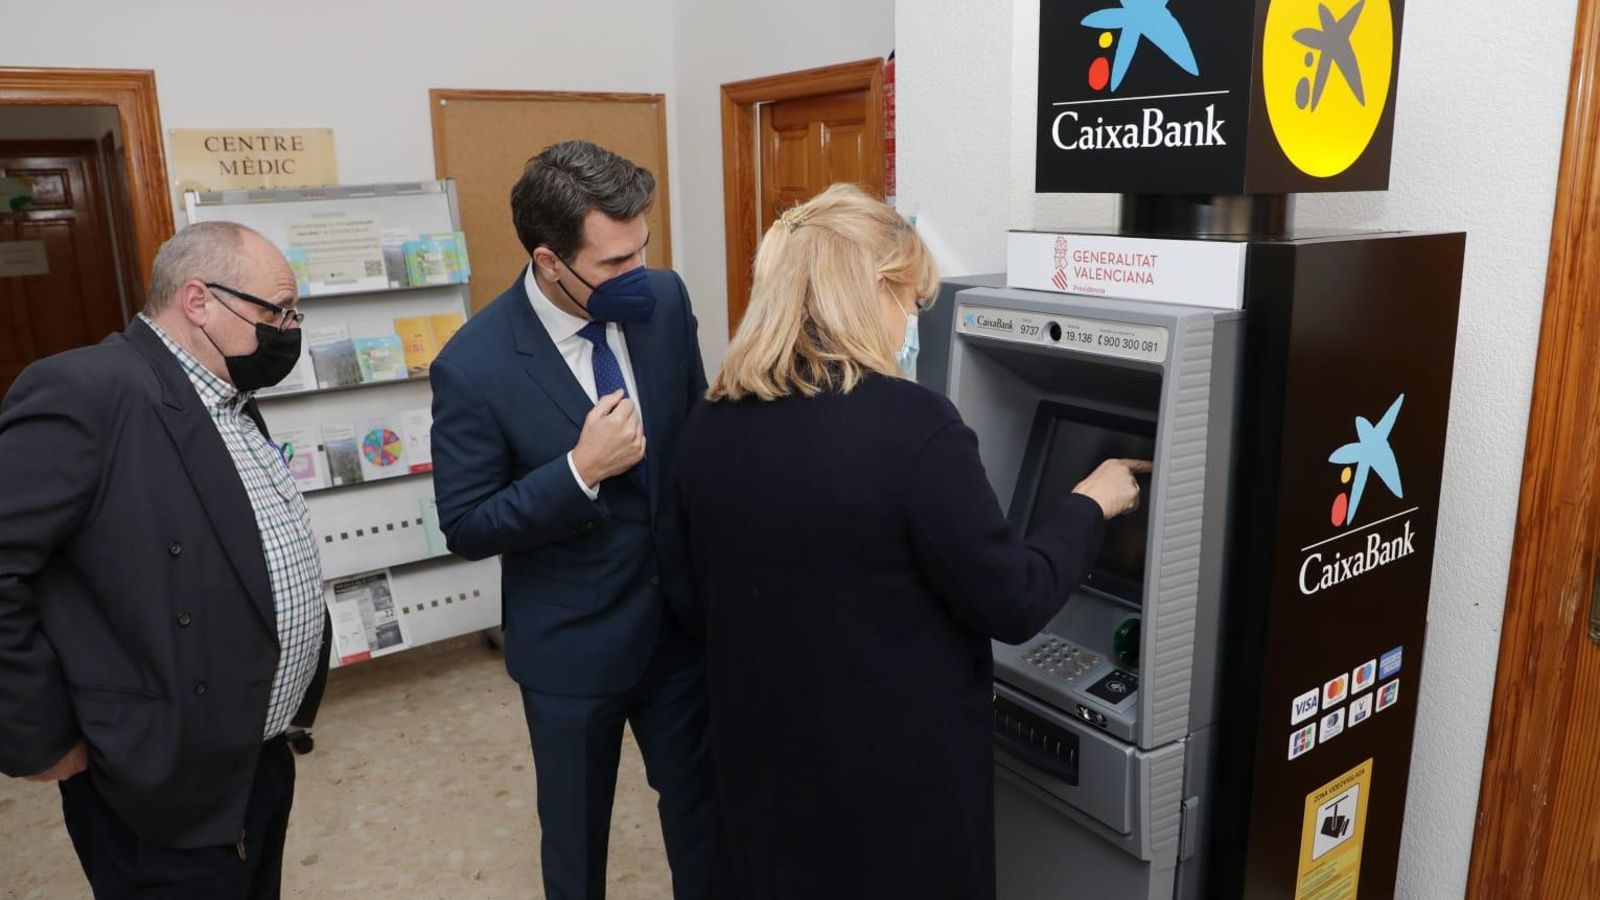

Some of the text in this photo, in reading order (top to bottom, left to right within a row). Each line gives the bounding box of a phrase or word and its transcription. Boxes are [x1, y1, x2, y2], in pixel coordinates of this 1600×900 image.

[1051, 103, 1227, 150] CaixaBank
[204, 135, 305, 152] CENTRE
[1073, 249, 1158, 267] GENERALITAT
[1073, 265, 1154, 285] VALENCIANA
[976, 314, 1014, 331] CaixaBank
[1020, 324, 1040, 336] 9737
[1103, 335, 1159, 353] 900 300 081
[1299, 519, 1416, 595] CaixaBank
[1295, 695, 1318, 717] VISA
